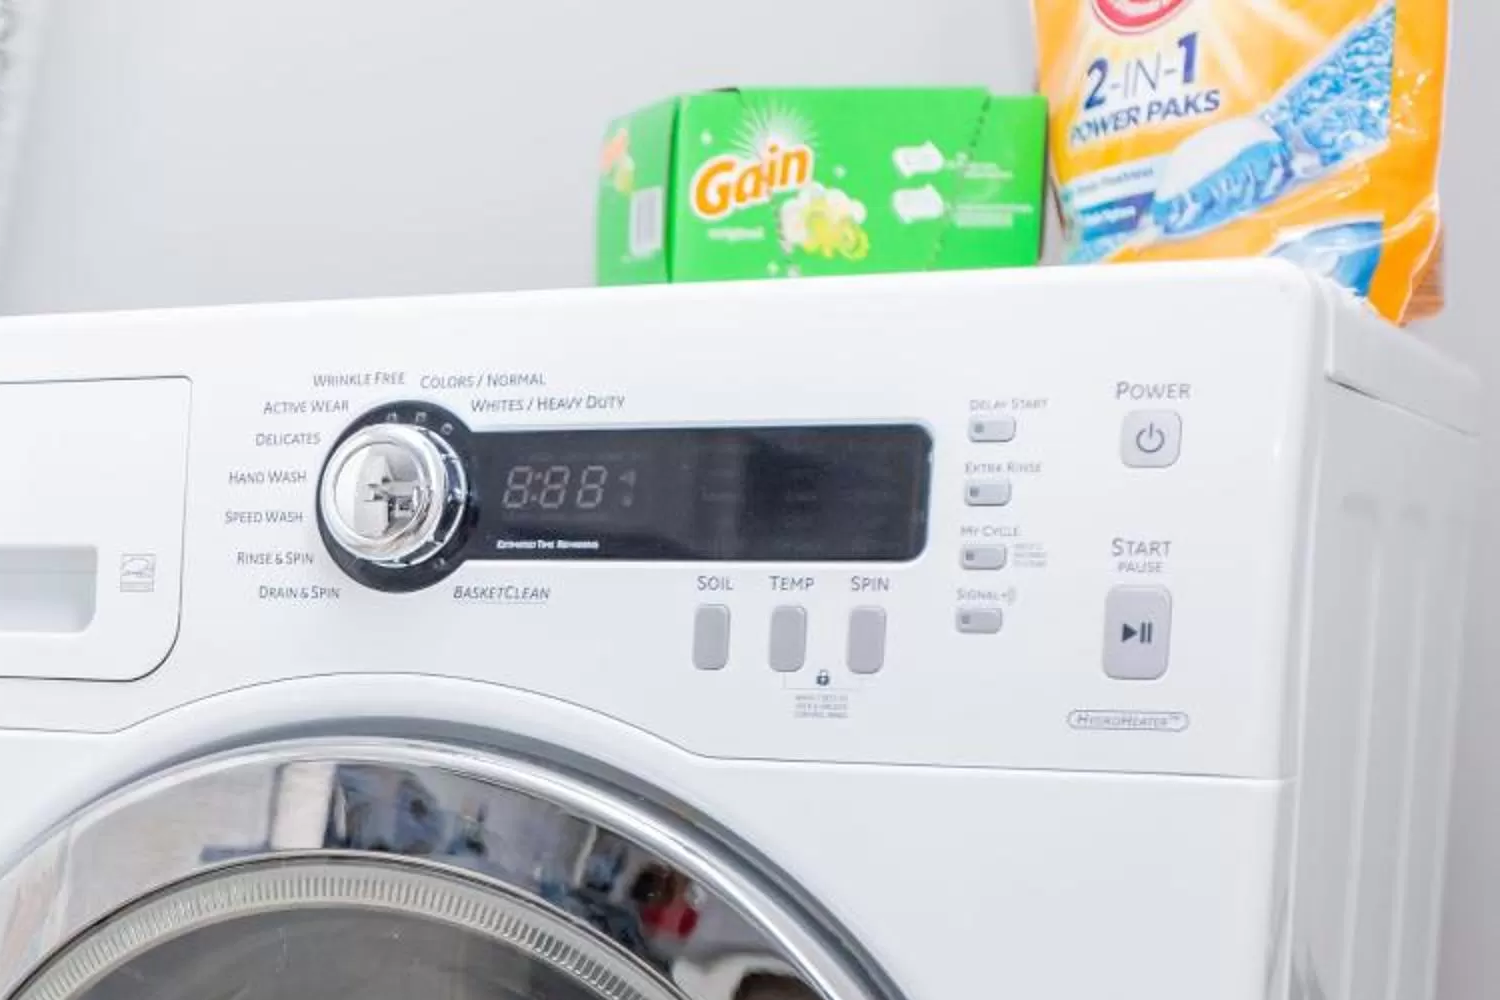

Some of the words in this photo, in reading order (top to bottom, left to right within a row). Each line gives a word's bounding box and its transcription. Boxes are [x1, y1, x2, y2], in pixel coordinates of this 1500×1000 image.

[1084, 31, 1198, 110] 2-IN-1
[1146, 88, 1221, 121] PAKS
[692, 142, 812, 218] Gain
[312, 372, 371, 388] WRINKLE
[373, 370, 406, 386] FREE
[419, 373, 475, 390] COLORS
[486, 371, 547, 388] NORMAL
[1115, 380, 1191, 400] POWER
[263, 402, 309, 415] ACTIVE
[312, 400, 350, 414] WEAR
[470, 397, 525, 413] WHITES
[536, 395, 583, 411] HEAVY
[585, 393, 626, 411] DUTY
[255, 431, 321, 446] DELICATES
[228, 471, 265, 484] HAND
[267, 470, 307, 484] WASH
[225, 510, 263, 525] SPEED
[265, 510, 304, 524] WASH
[1111, 537, 1172, 558] START
[237, 551, 275, 565] RINSE
[286, 550, 315, 565] SPIN
[258, 585, 299, 600] DRAIN
[311, 585, 341, 600] SPIN
[453, 585, 550, 601] BASKETCLEAN
[696, 576, 734, 593] SOIL
[768, 576, 815, 593] TEMP
[850, 576, 890, 593] SPIN
